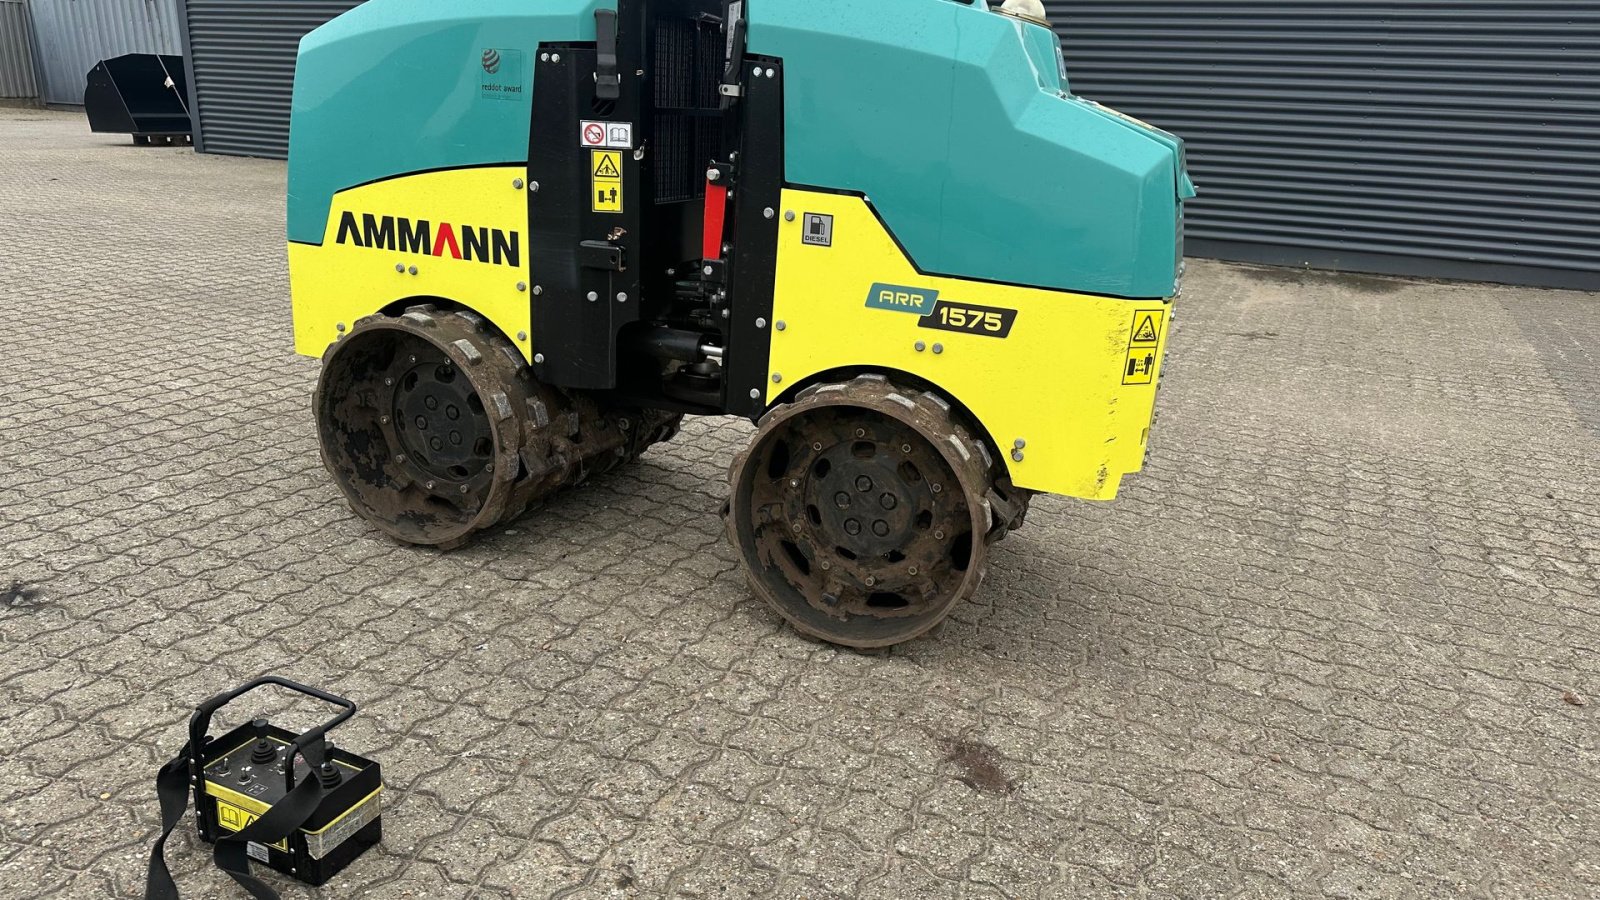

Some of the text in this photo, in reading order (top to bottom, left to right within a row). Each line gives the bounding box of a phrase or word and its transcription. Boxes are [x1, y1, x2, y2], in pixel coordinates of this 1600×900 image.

[503, 85, 522, 93] award
[335, 210, 520, 268] AMMANN
[804, 235, 829, 244] DIESEL
[879, 290, 924, 308] ARR
[939, 306, 1002, 332] 1575
